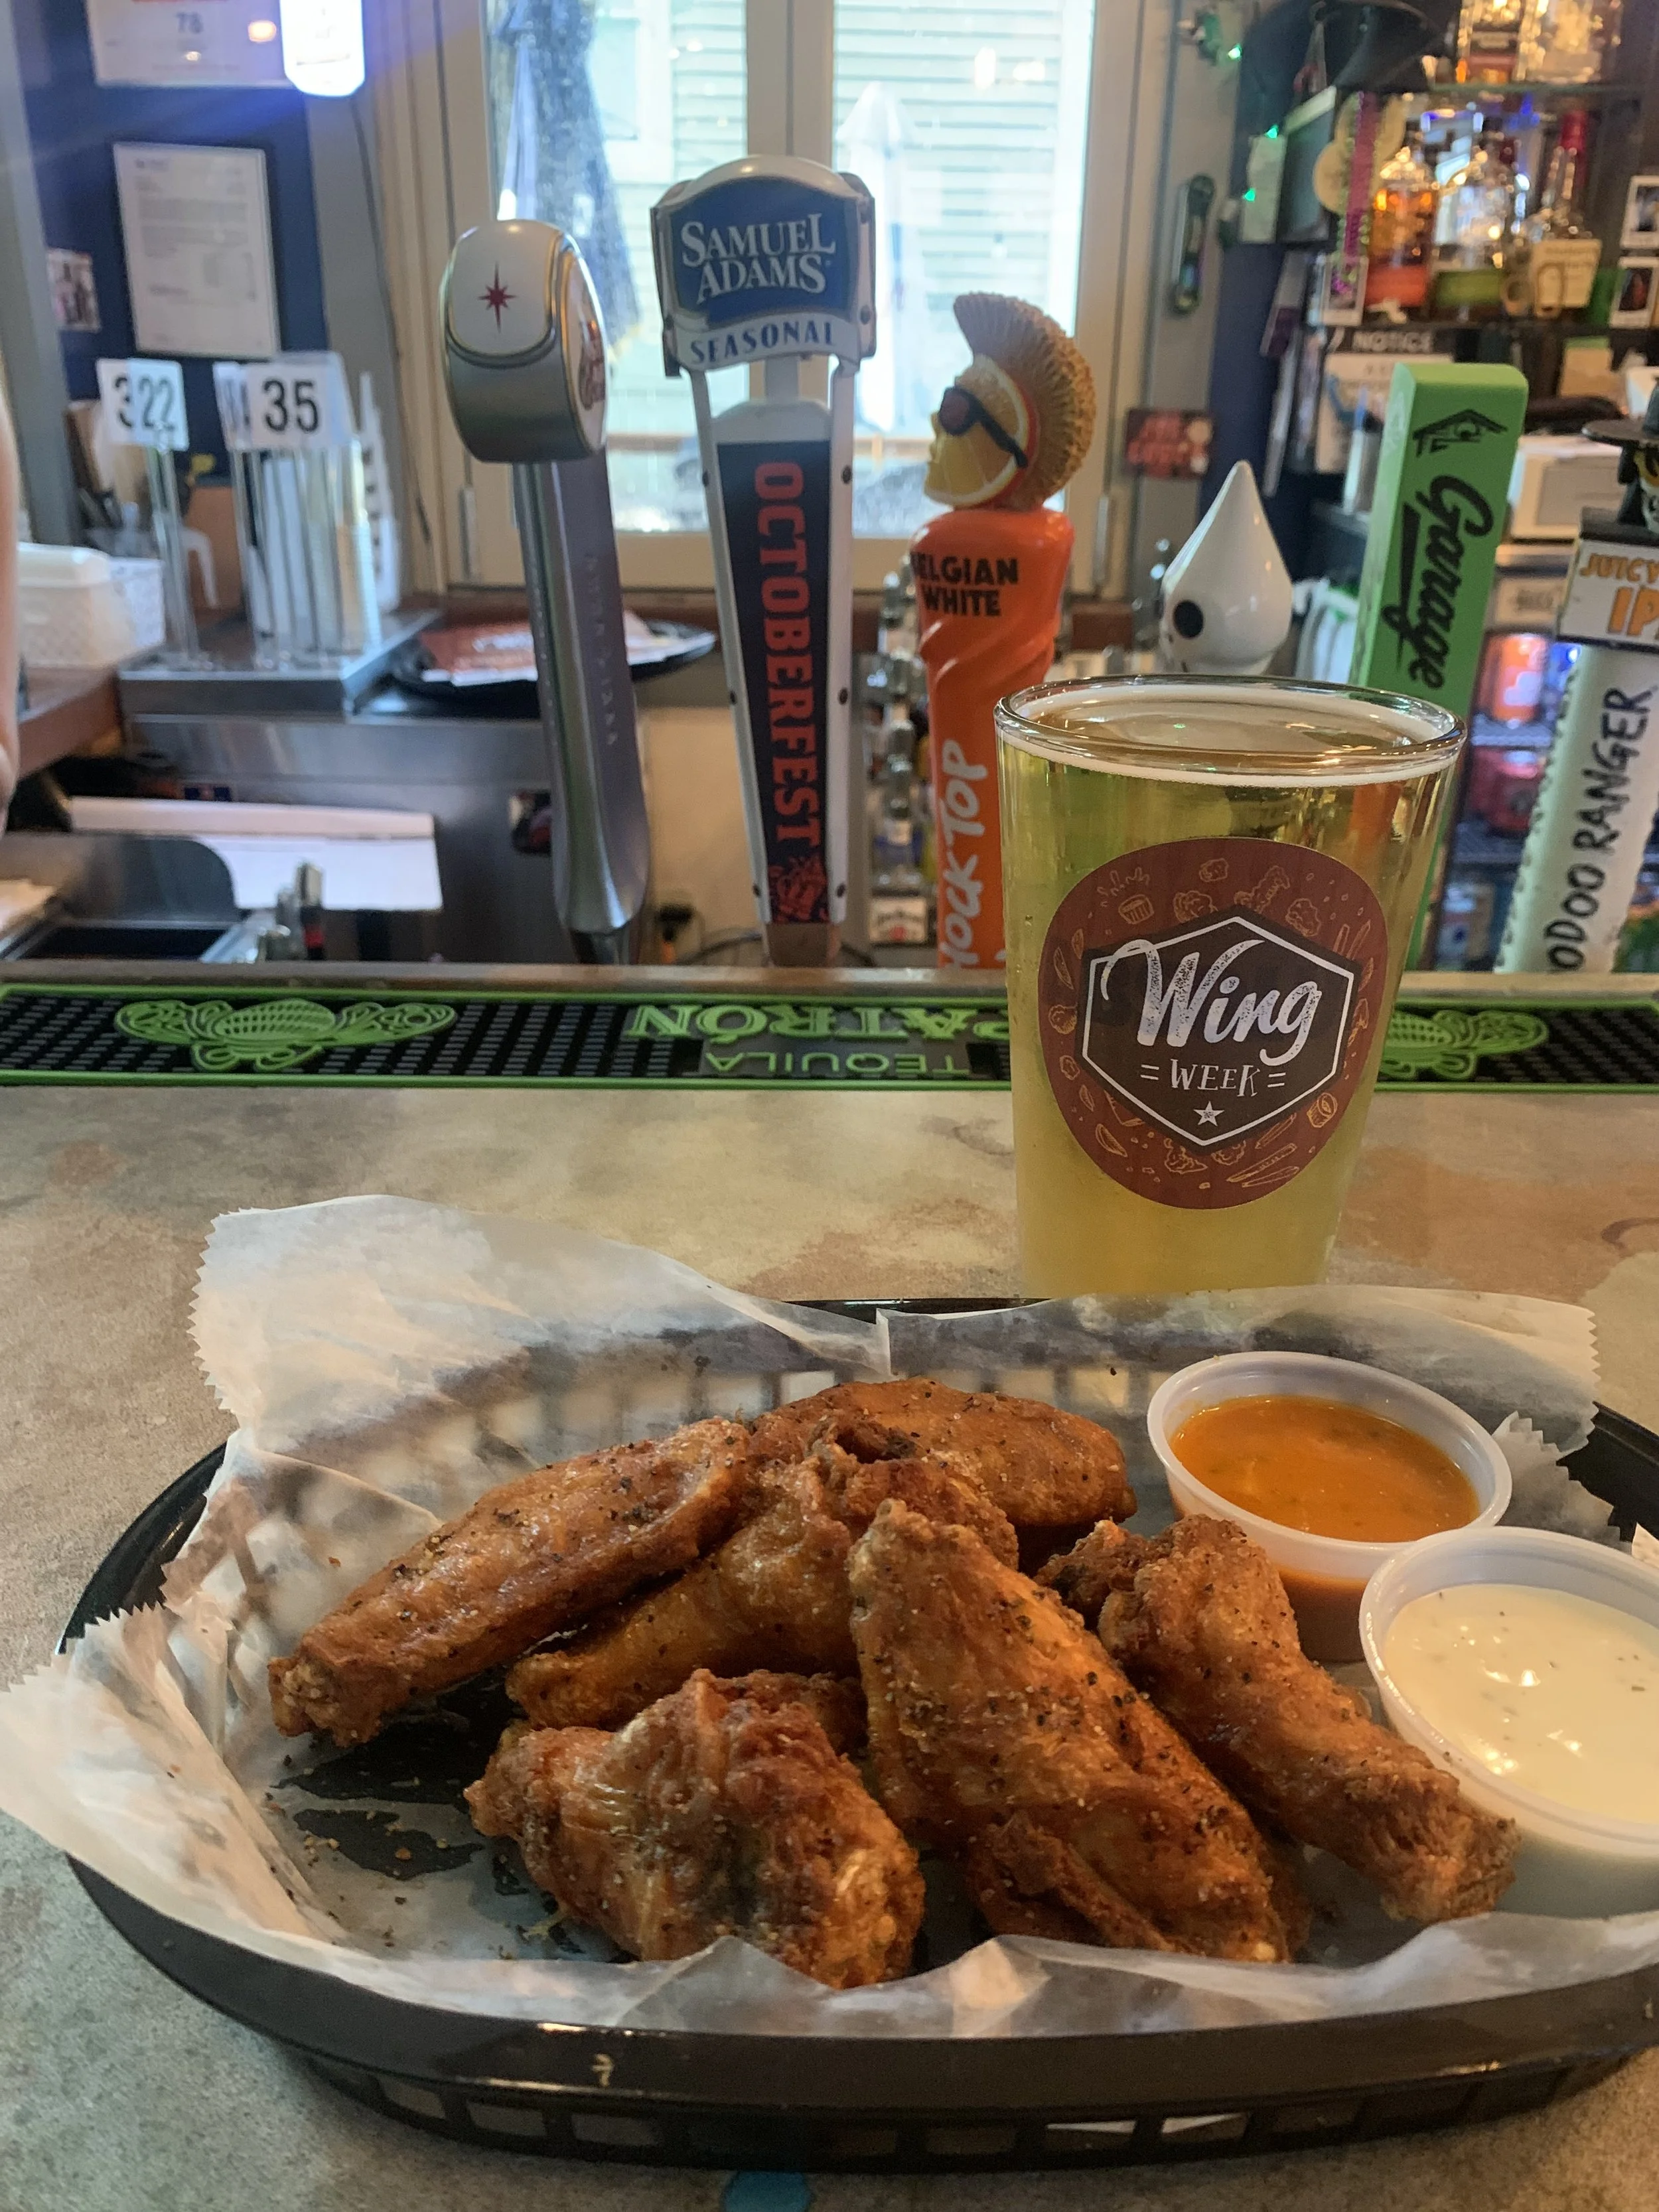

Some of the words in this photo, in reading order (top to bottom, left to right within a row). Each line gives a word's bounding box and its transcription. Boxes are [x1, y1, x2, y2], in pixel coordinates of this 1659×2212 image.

[681, 213, 836, 267] SAMUEL
[697, 254, 826, 305] ADAMS
[691, 320, 835, 364] SEASONAL
[263, 379, 320, 433] 35
[922, 586, 1001, 617] WHITE
[1381, 475, 1494, 689] Garage
[1607, 586, 1659, 639] IP
[754, 461, 822, 847] OCTOBERFEST
[938, 739, 989, 847] TOP
[1572, 686, 1657, 852] RANGER
[938, 850, 983, 969] HOCK
[1544, 863, 1605, 973] ODOO
[1100, 938, 1322, 1067] Wing
[705, 1052, 970, 1073] TEQUILA
[1170, 1058, 1261, 1098] WEEK
